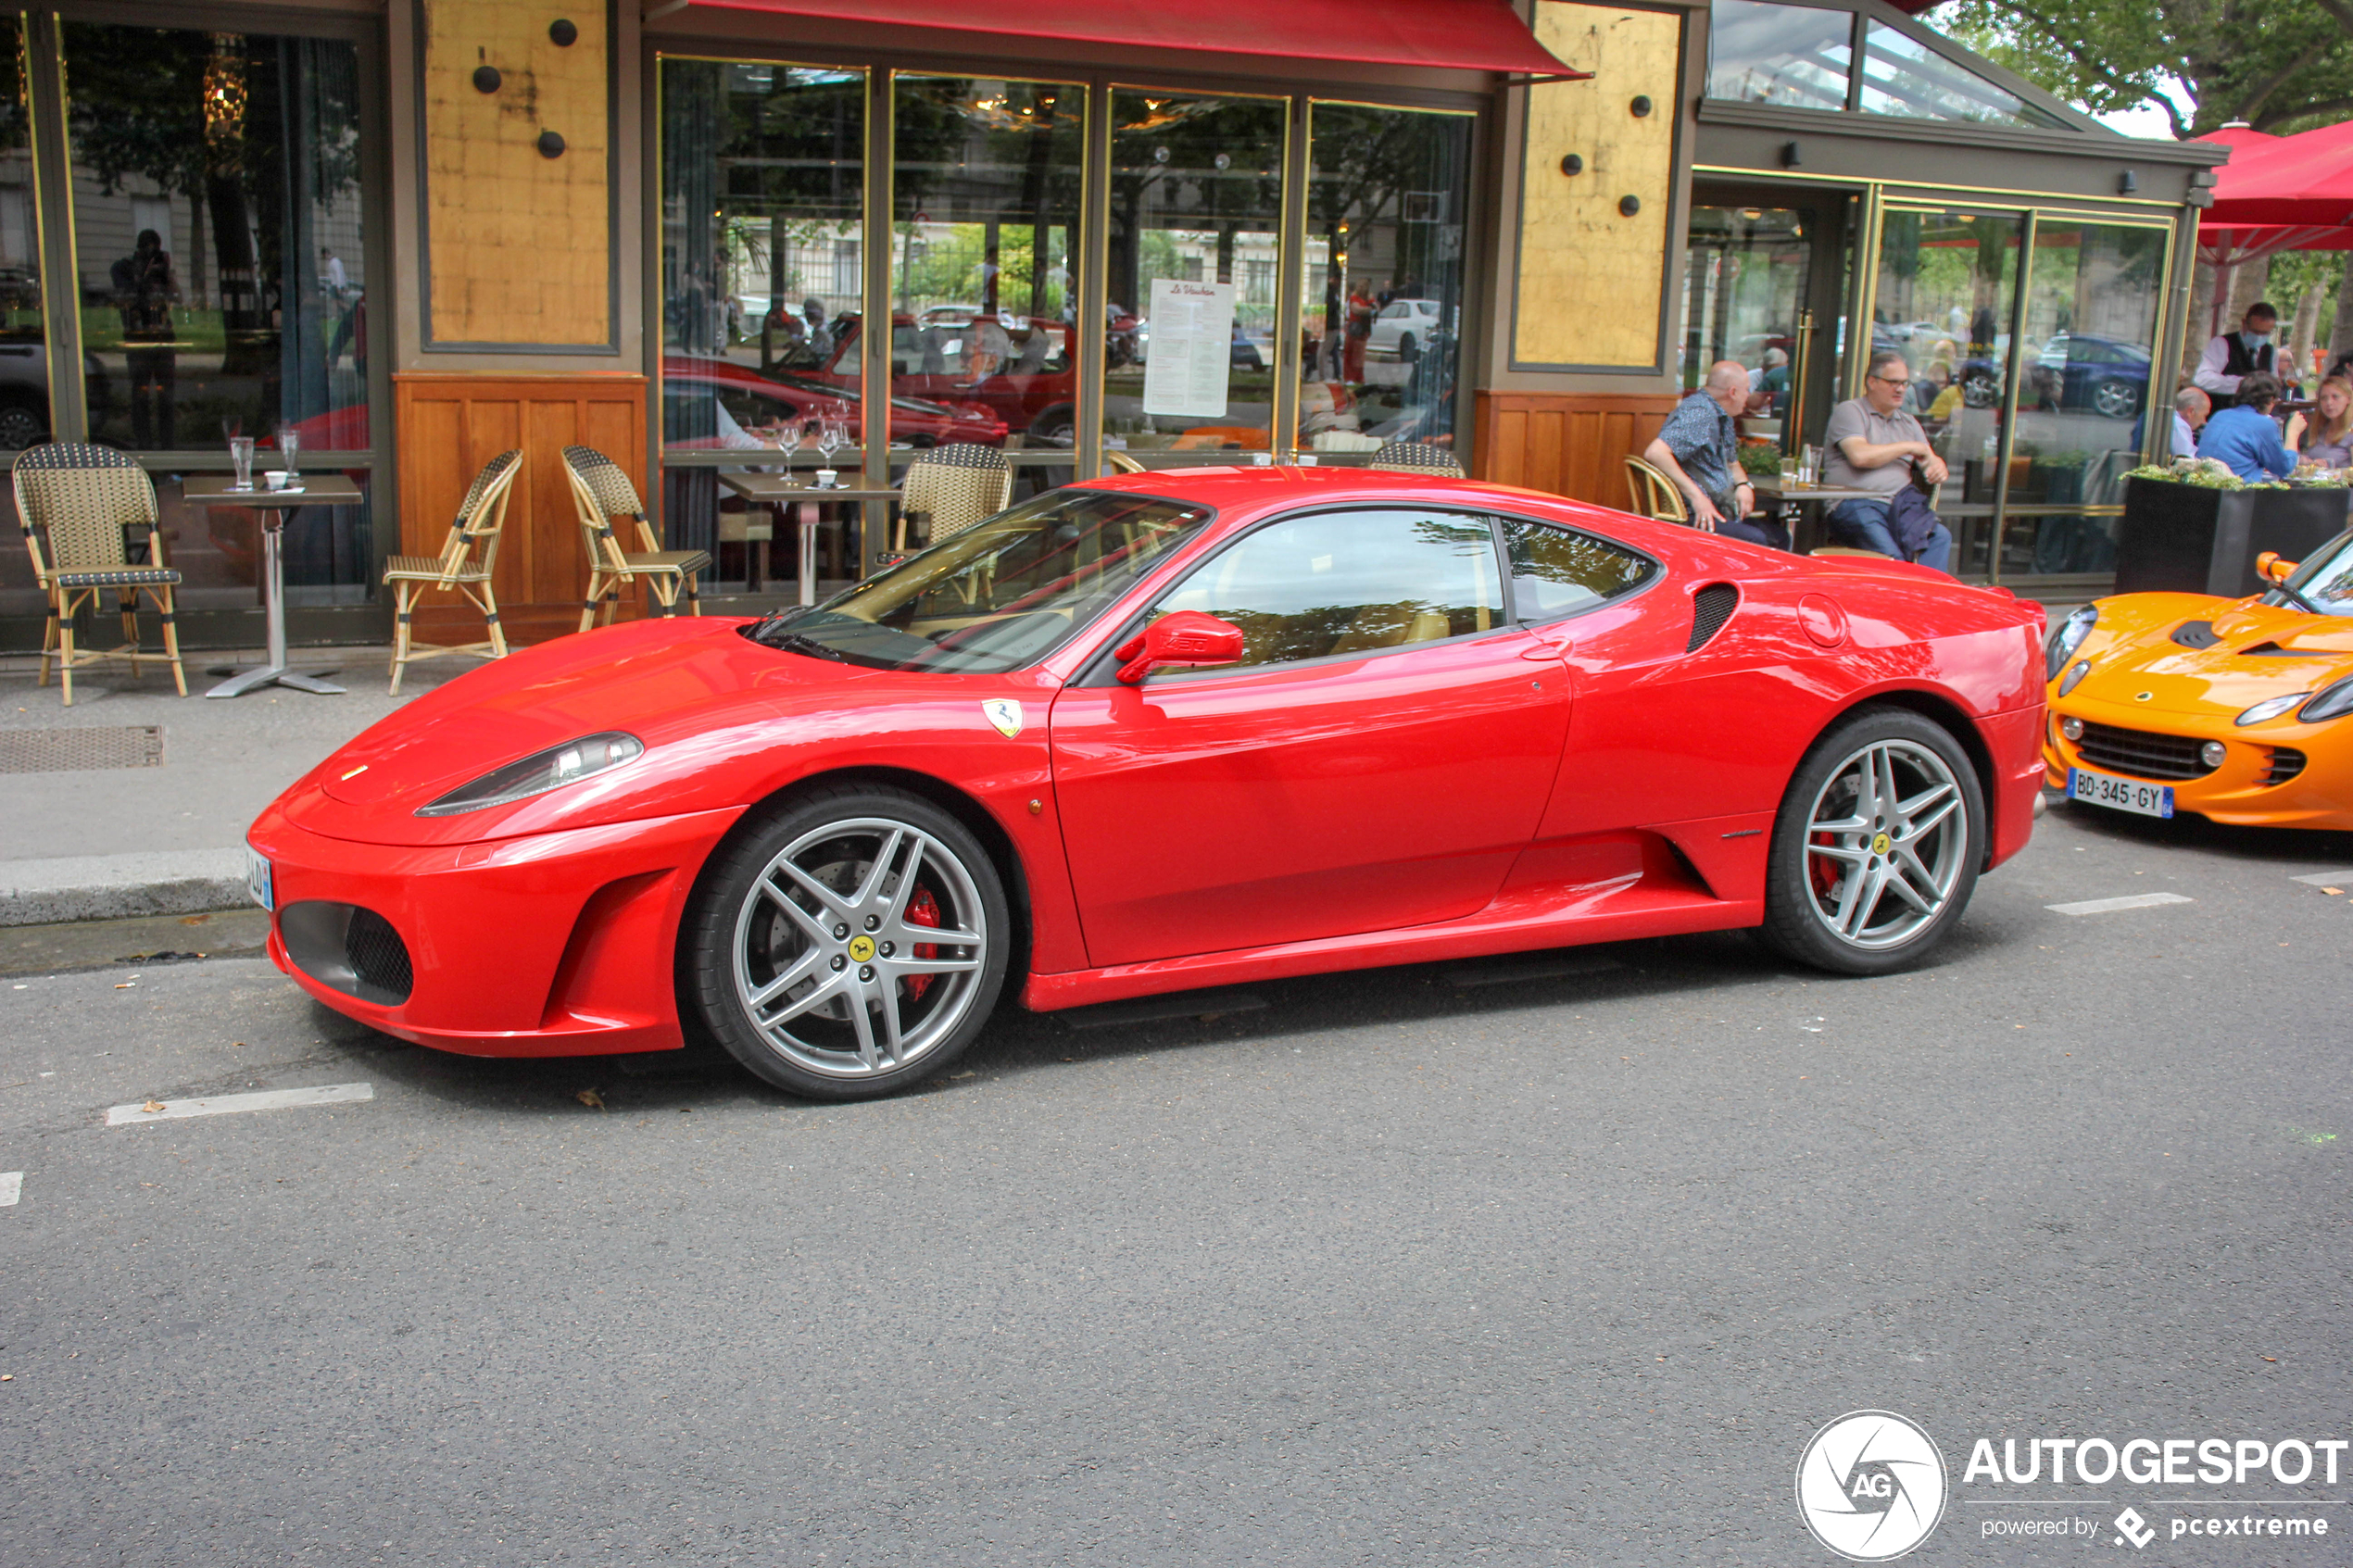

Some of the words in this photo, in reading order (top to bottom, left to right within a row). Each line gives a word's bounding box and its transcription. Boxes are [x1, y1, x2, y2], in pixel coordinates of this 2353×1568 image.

[1170, 283, 1181, 294] Le
[2077, 773, 2160, 809] BD-345-GY
[2162, 803, 2173, 815] 64
